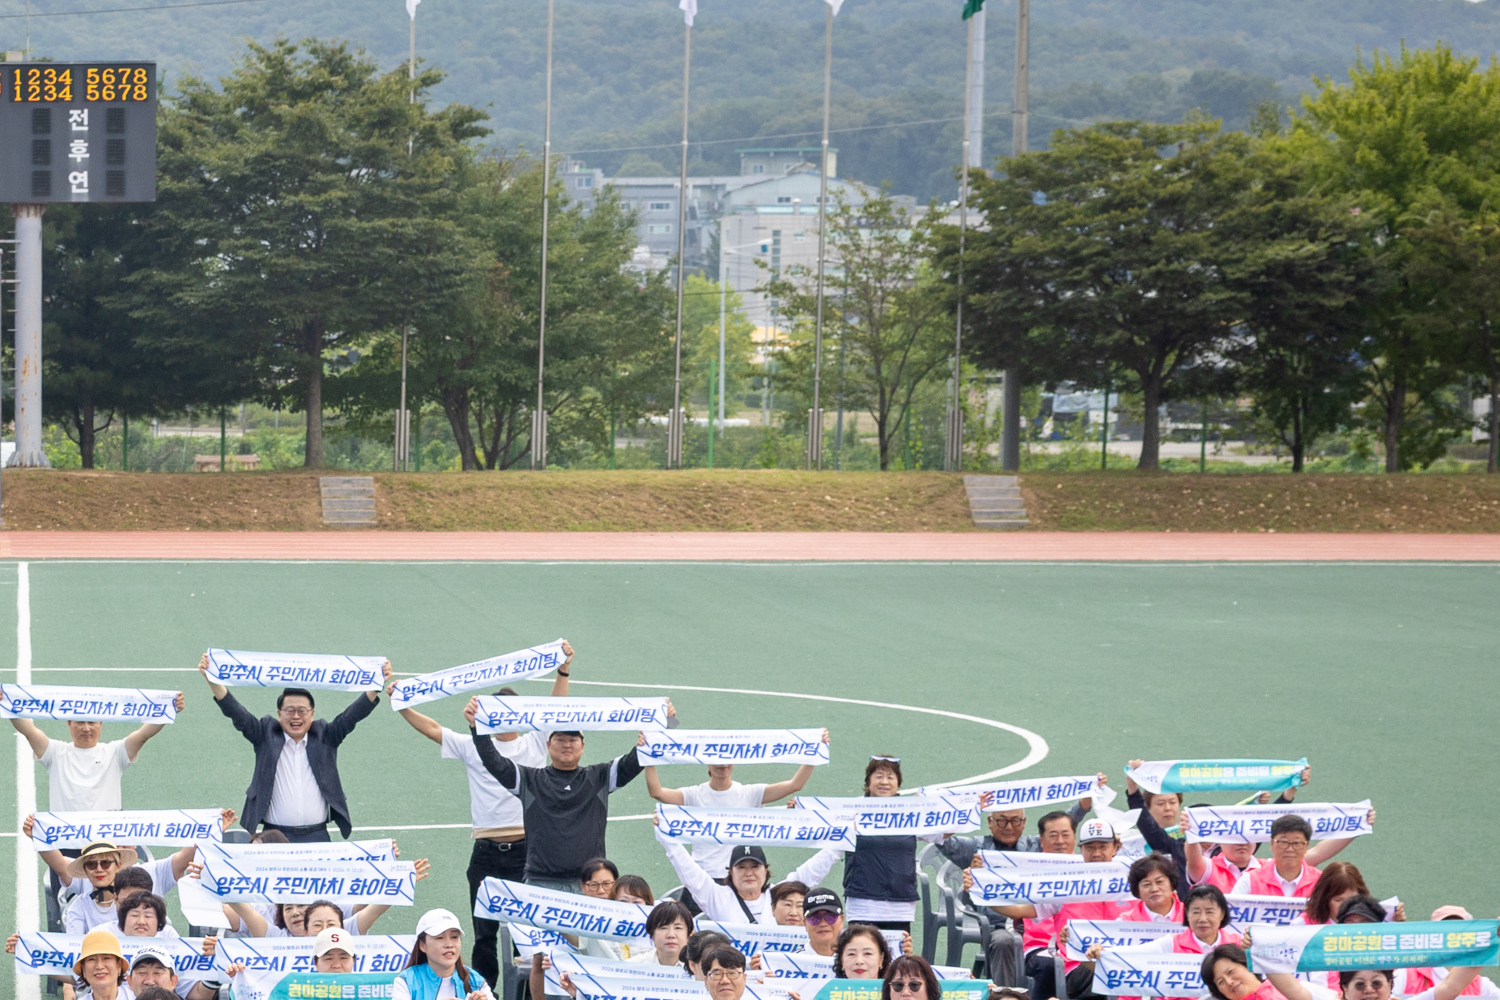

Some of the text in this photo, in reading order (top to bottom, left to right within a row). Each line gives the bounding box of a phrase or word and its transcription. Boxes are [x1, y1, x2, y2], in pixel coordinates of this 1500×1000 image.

[14, 69, 148, 85] 1234 5678
[14, 85, 148, 101] 1234 5678
[69, 109, 89, 131] 전
[69, 140, 90, 162] 후
[69, 171, 89, 193] 연
[218, 664, 375, 686] 양주시 주민자치 화이팅
[402, 677, 444, 701] 양주시
[449, 664, 509, 688] 주민자치
[514, 651, 559, 675] 화이팅
[11, 698, 167, 717] 양주시 주민자치 화이팅
[487, 708, 655, 727] 양주시 주민자치 화이팅
[651, 741, 819, 759] 양주시 주민자치 화이팅
[858, 812, 921, 829] 주민자치
[925, 809, 970, 826] 화이팅
[1197, 814, 1363, 837] 양주시 화이팅
[45, 823, 212, 842] 양주시 주민자치 화이팅
[669, 818, 848, 842] 양주시 주민자치 화이팅
[217, 876, 404, 895] 양주시 주민자치 화이팅
[1323, 931, 1491, 952] 경마공원은 준비된 양주로
